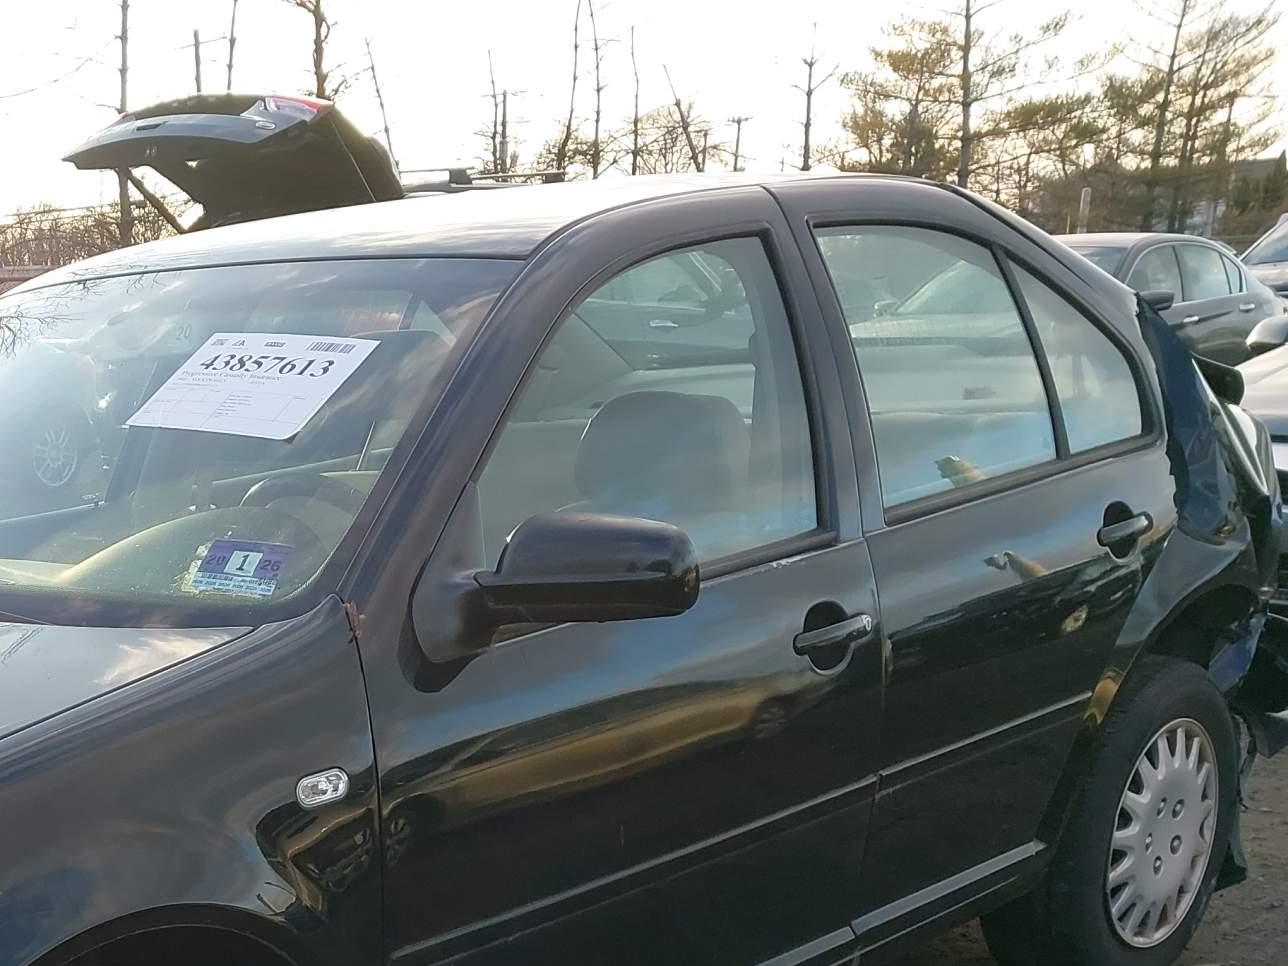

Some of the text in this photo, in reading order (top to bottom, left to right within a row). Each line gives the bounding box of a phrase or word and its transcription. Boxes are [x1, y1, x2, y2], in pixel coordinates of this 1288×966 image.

[200, 353, 335, 378] 43857613
[235, 553, 250, 571] 1
[260, 559, 282, 572] 26
